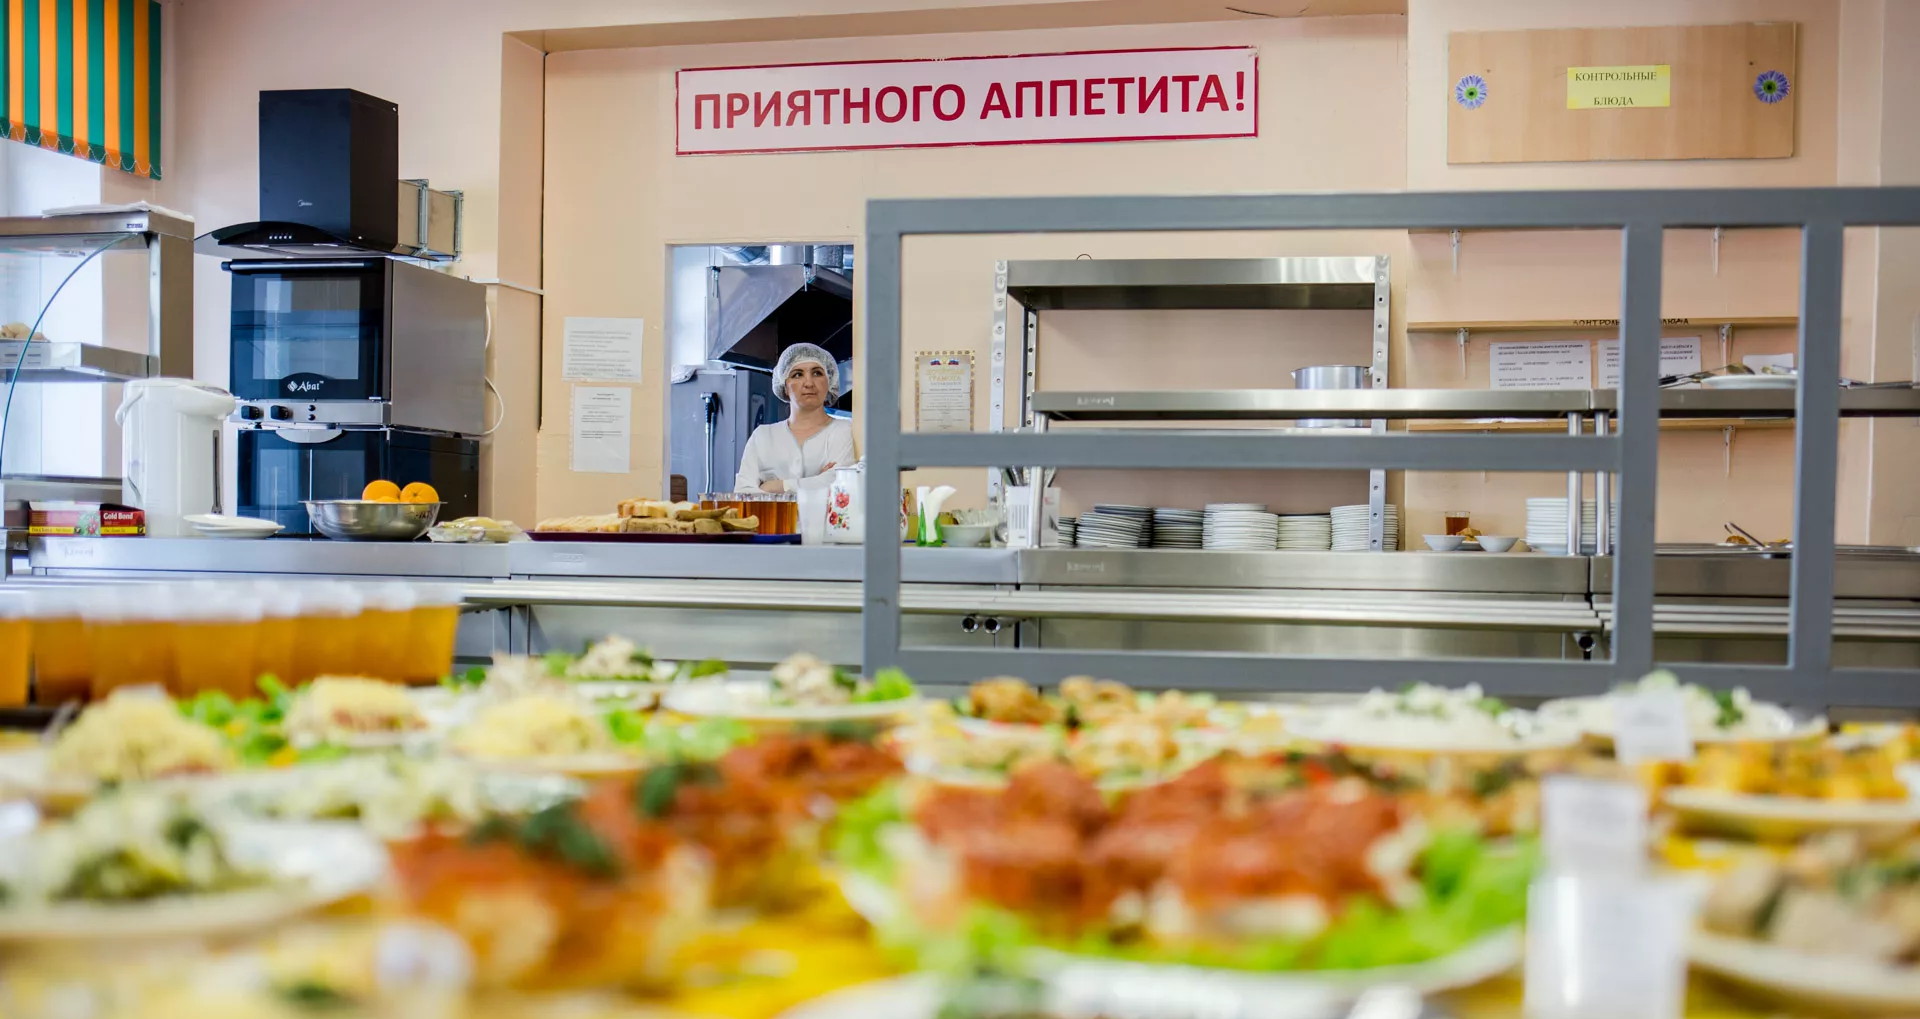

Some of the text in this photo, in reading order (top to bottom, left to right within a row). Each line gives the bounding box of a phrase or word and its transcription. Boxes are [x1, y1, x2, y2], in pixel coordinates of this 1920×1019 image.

[1575, 71, 1657, 82] КОНТРОЛЬНЫЕ
[694, 71, 1246, 130] ПРИЯТНОГО АППЕТИТА!
[1593, 96, 1634, 106] БЛЮДА
[103, 512, 134, 520] Gold Bond
